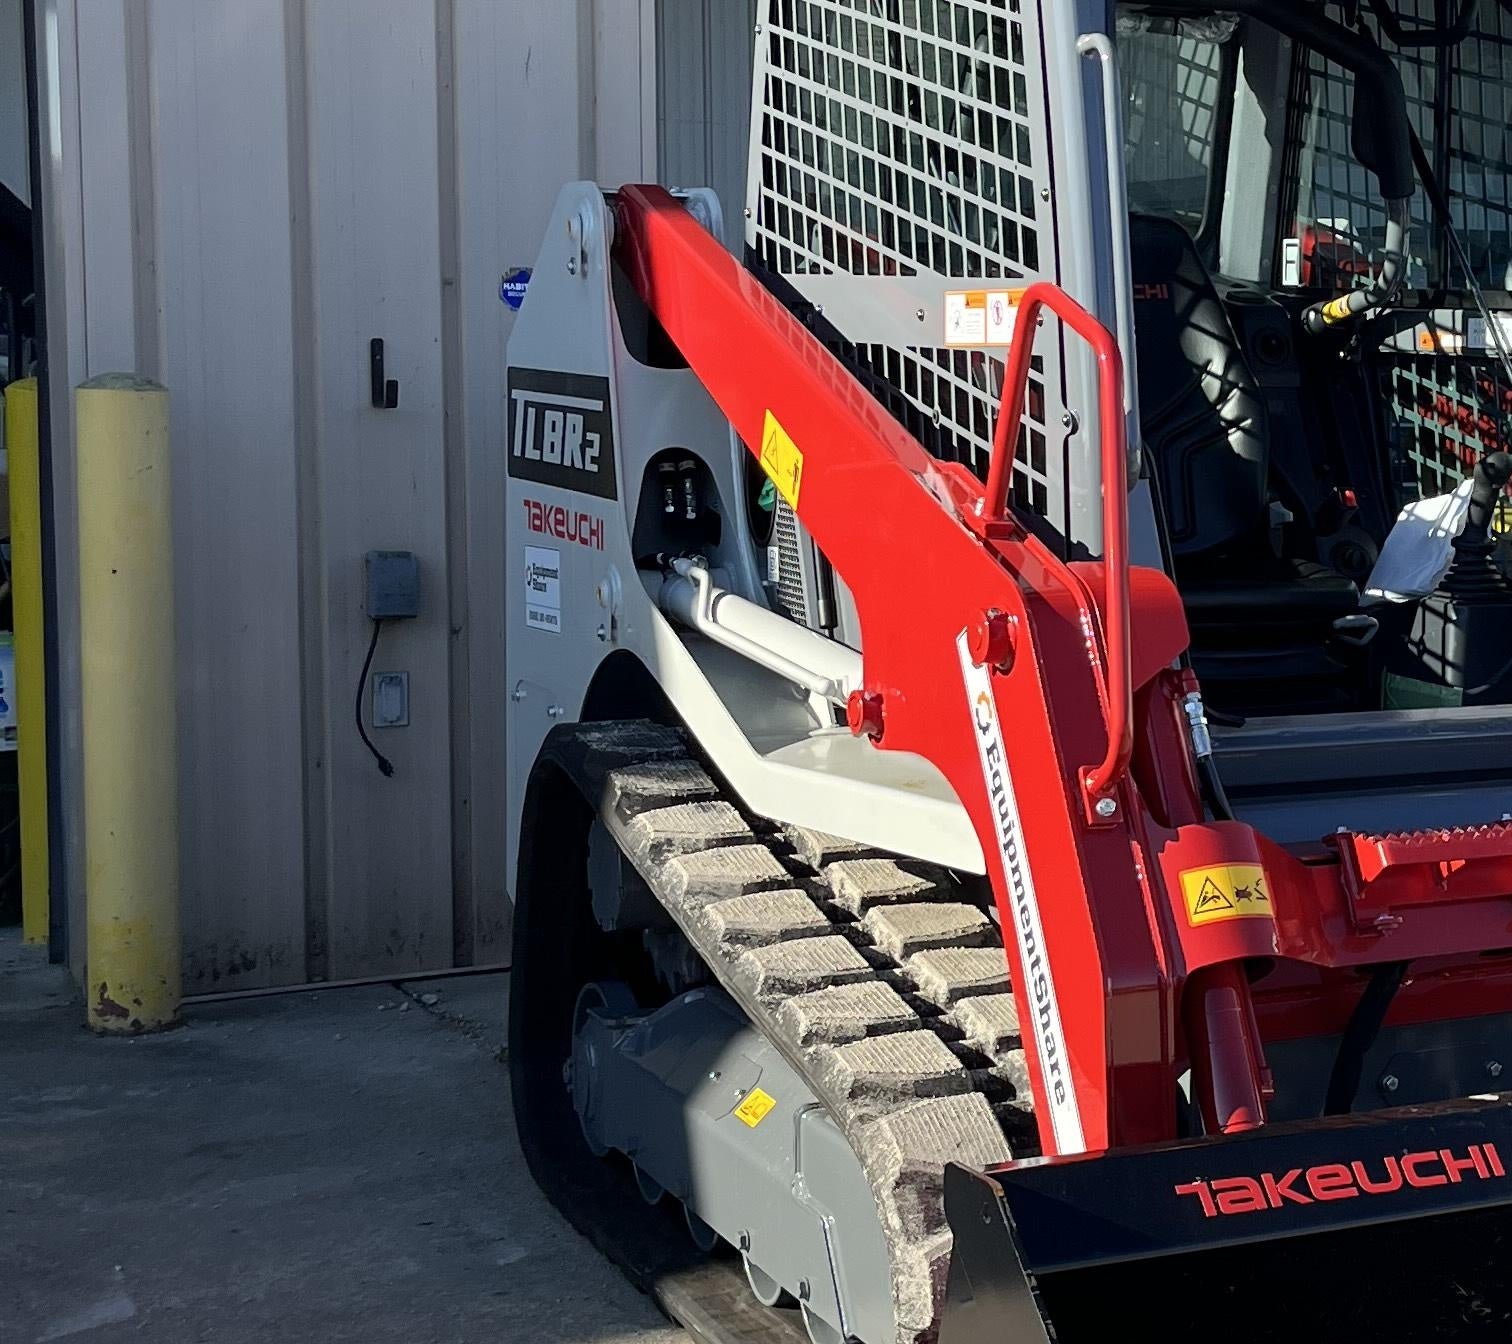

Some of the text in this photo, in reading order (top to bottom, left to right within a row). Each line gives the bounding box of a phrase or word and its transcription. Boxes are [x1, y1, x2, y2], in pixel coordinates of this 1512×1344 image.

[511, 388, 604, 473] TL8R2
[523, 498, 605, 551] TAKEUCHI
[984, 736, 1067, 1107] EquipmentShare
[1174, 1142, 1506, 1218] TAKEUCHI
